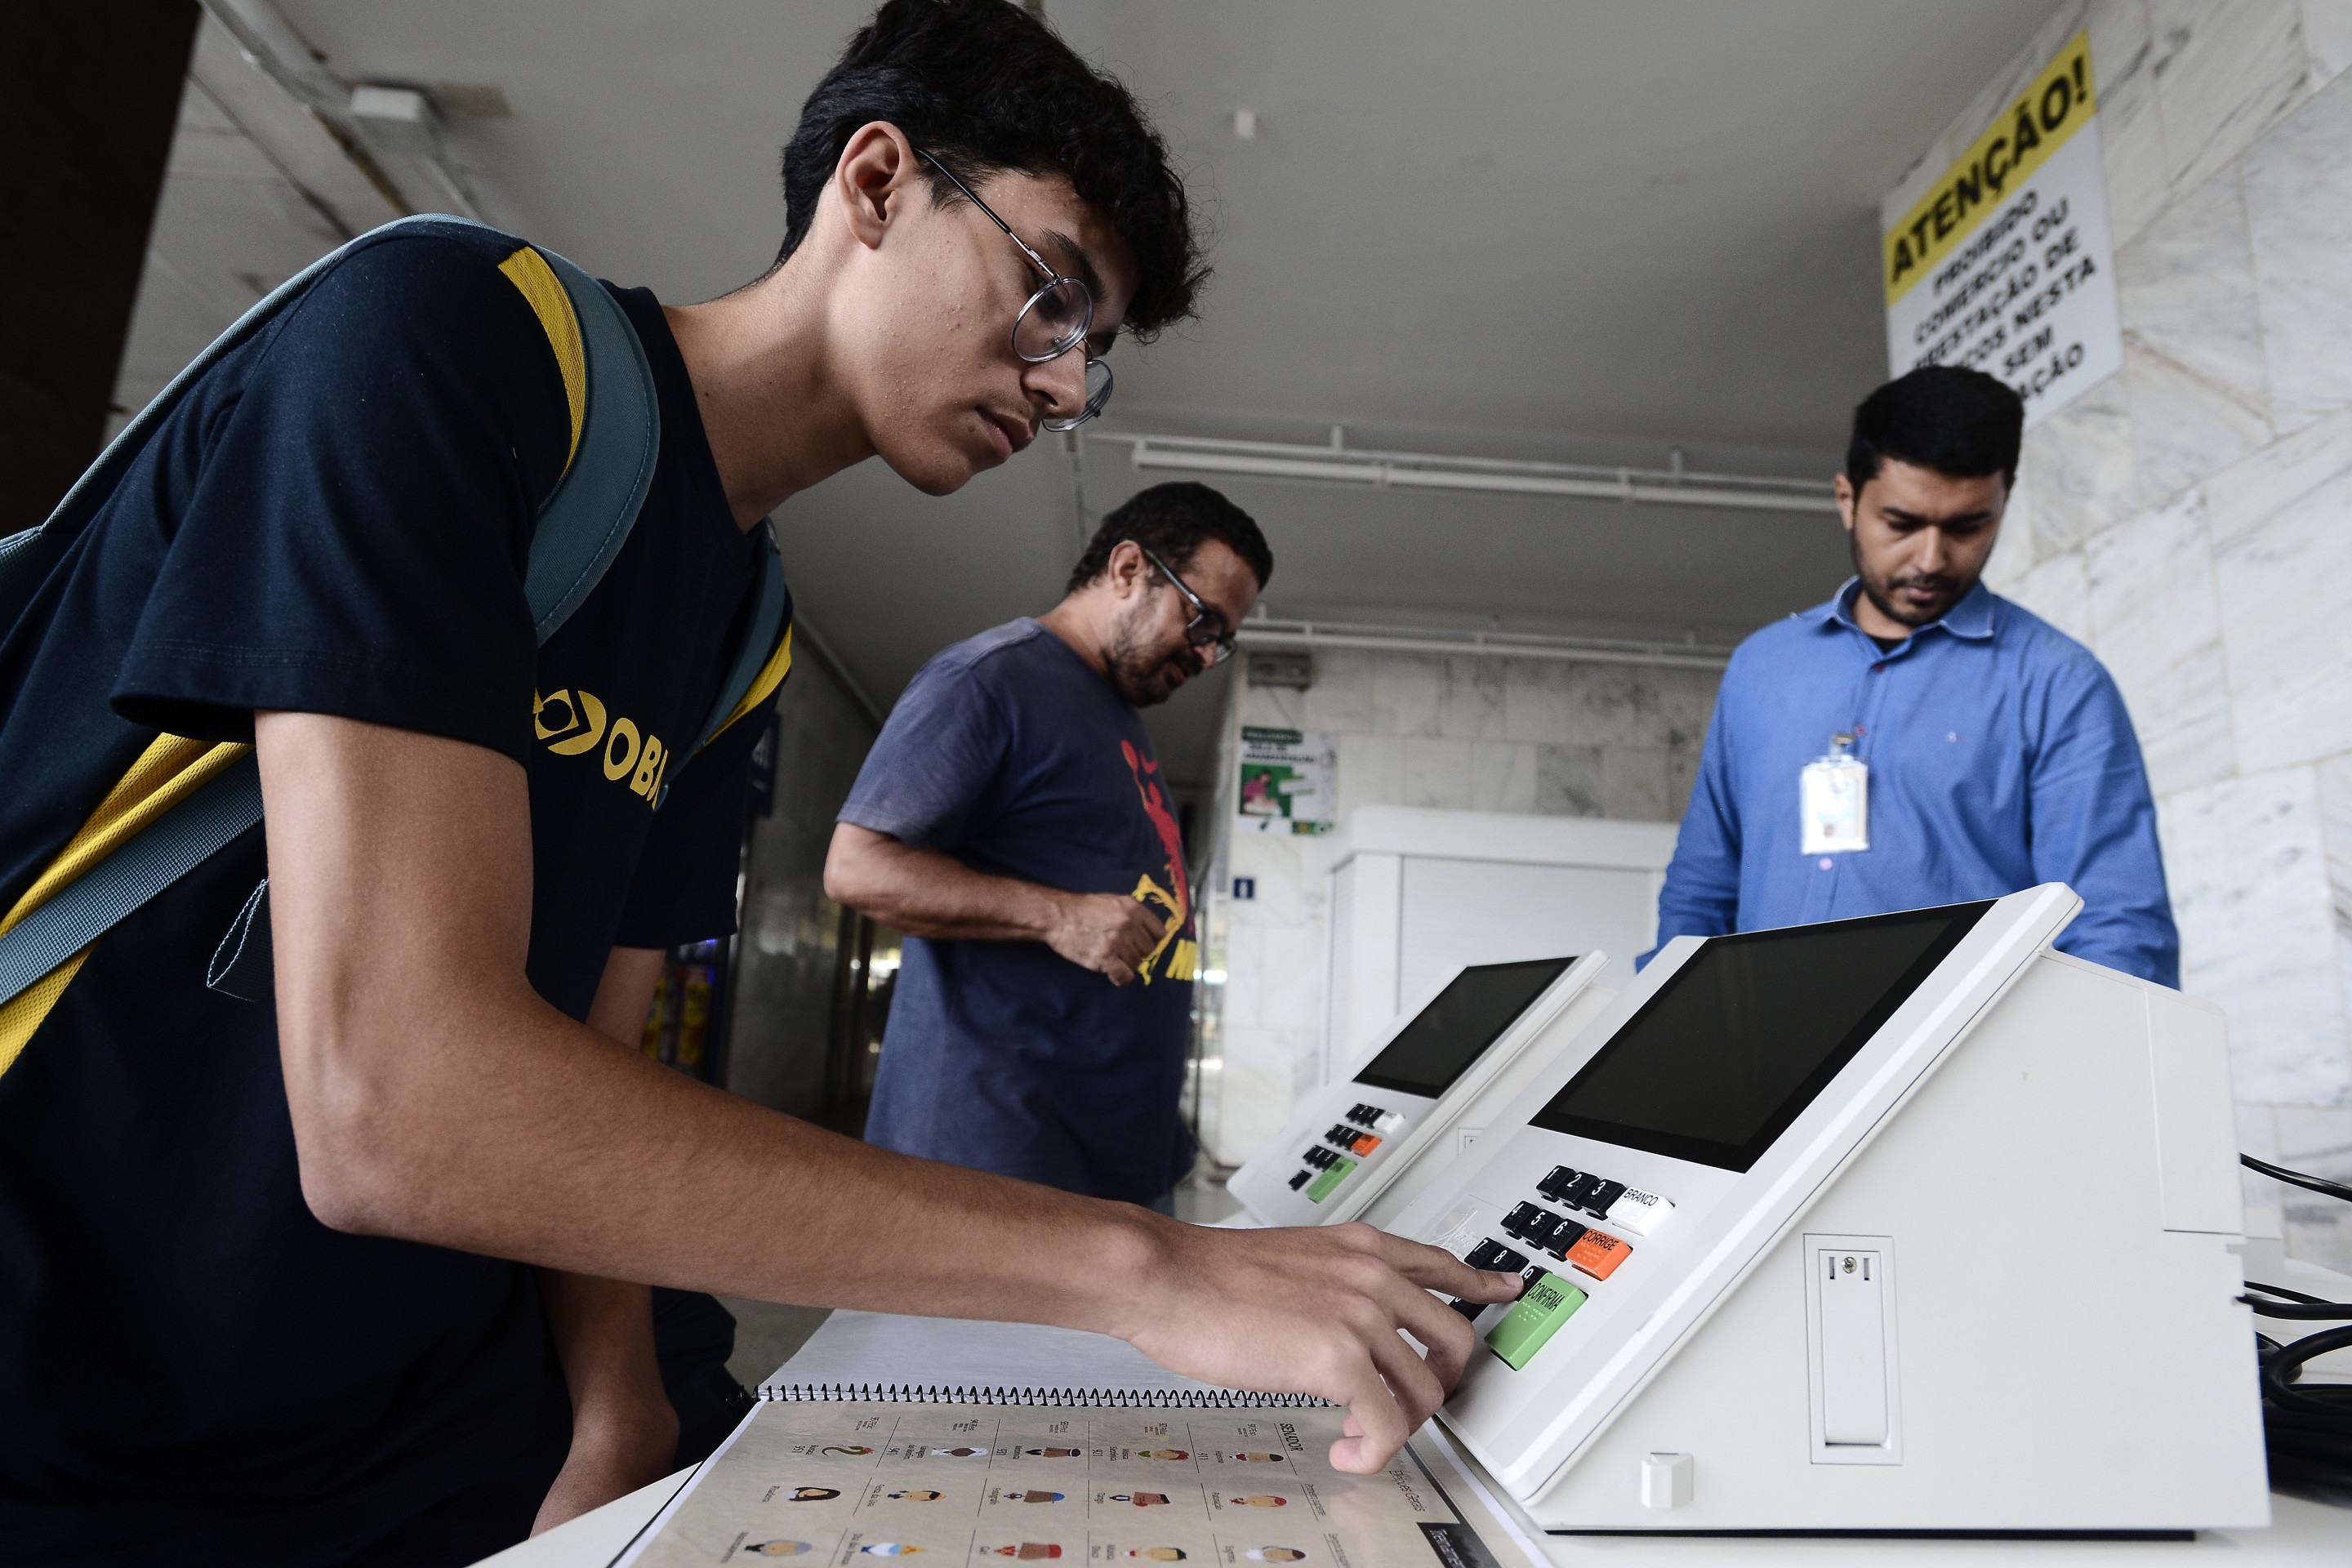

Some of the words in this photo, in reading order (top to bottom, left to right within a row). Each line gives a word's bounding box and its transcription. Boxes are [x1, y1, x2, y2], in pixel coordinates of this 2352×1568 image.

[1891, 55, 2088, 284] ATENÇÃO!
[2032, 196, 2069, 243] OU
[1932, 190, 2038, 297] PROIBIDO
[2046, 226, 2079, 270] DE
[2012, 255, 2097, 332] NESTA
[2002, 325, 2054, 377] SEM
[1548, 1167, 1560, 1180] 1
[1567, 1174, 1583, 1188] 2
[1592, 1181, 1606, 1196] 3
[1624, 1188, 1659, 1206] BRANCO
[1511, 1204, 1524, 1216] 4
[1531, 1211, 1546, 1225] 5
[1553, 1221, 1568, 1236] 6
[1582, 1230, 1619, 1251] CORRIGE
[1474, 1239, 1489, 1252] 7
[1493, 1250, 1508, 1263] 8
[1526, 1282, 1566, 1312] CONFIRMA
[1092, 1449, 1103, 1457] 921
[1280, 1423, 1304, 1451] SENADOR
[1405, 1491, 1428, 1512] Gerais
